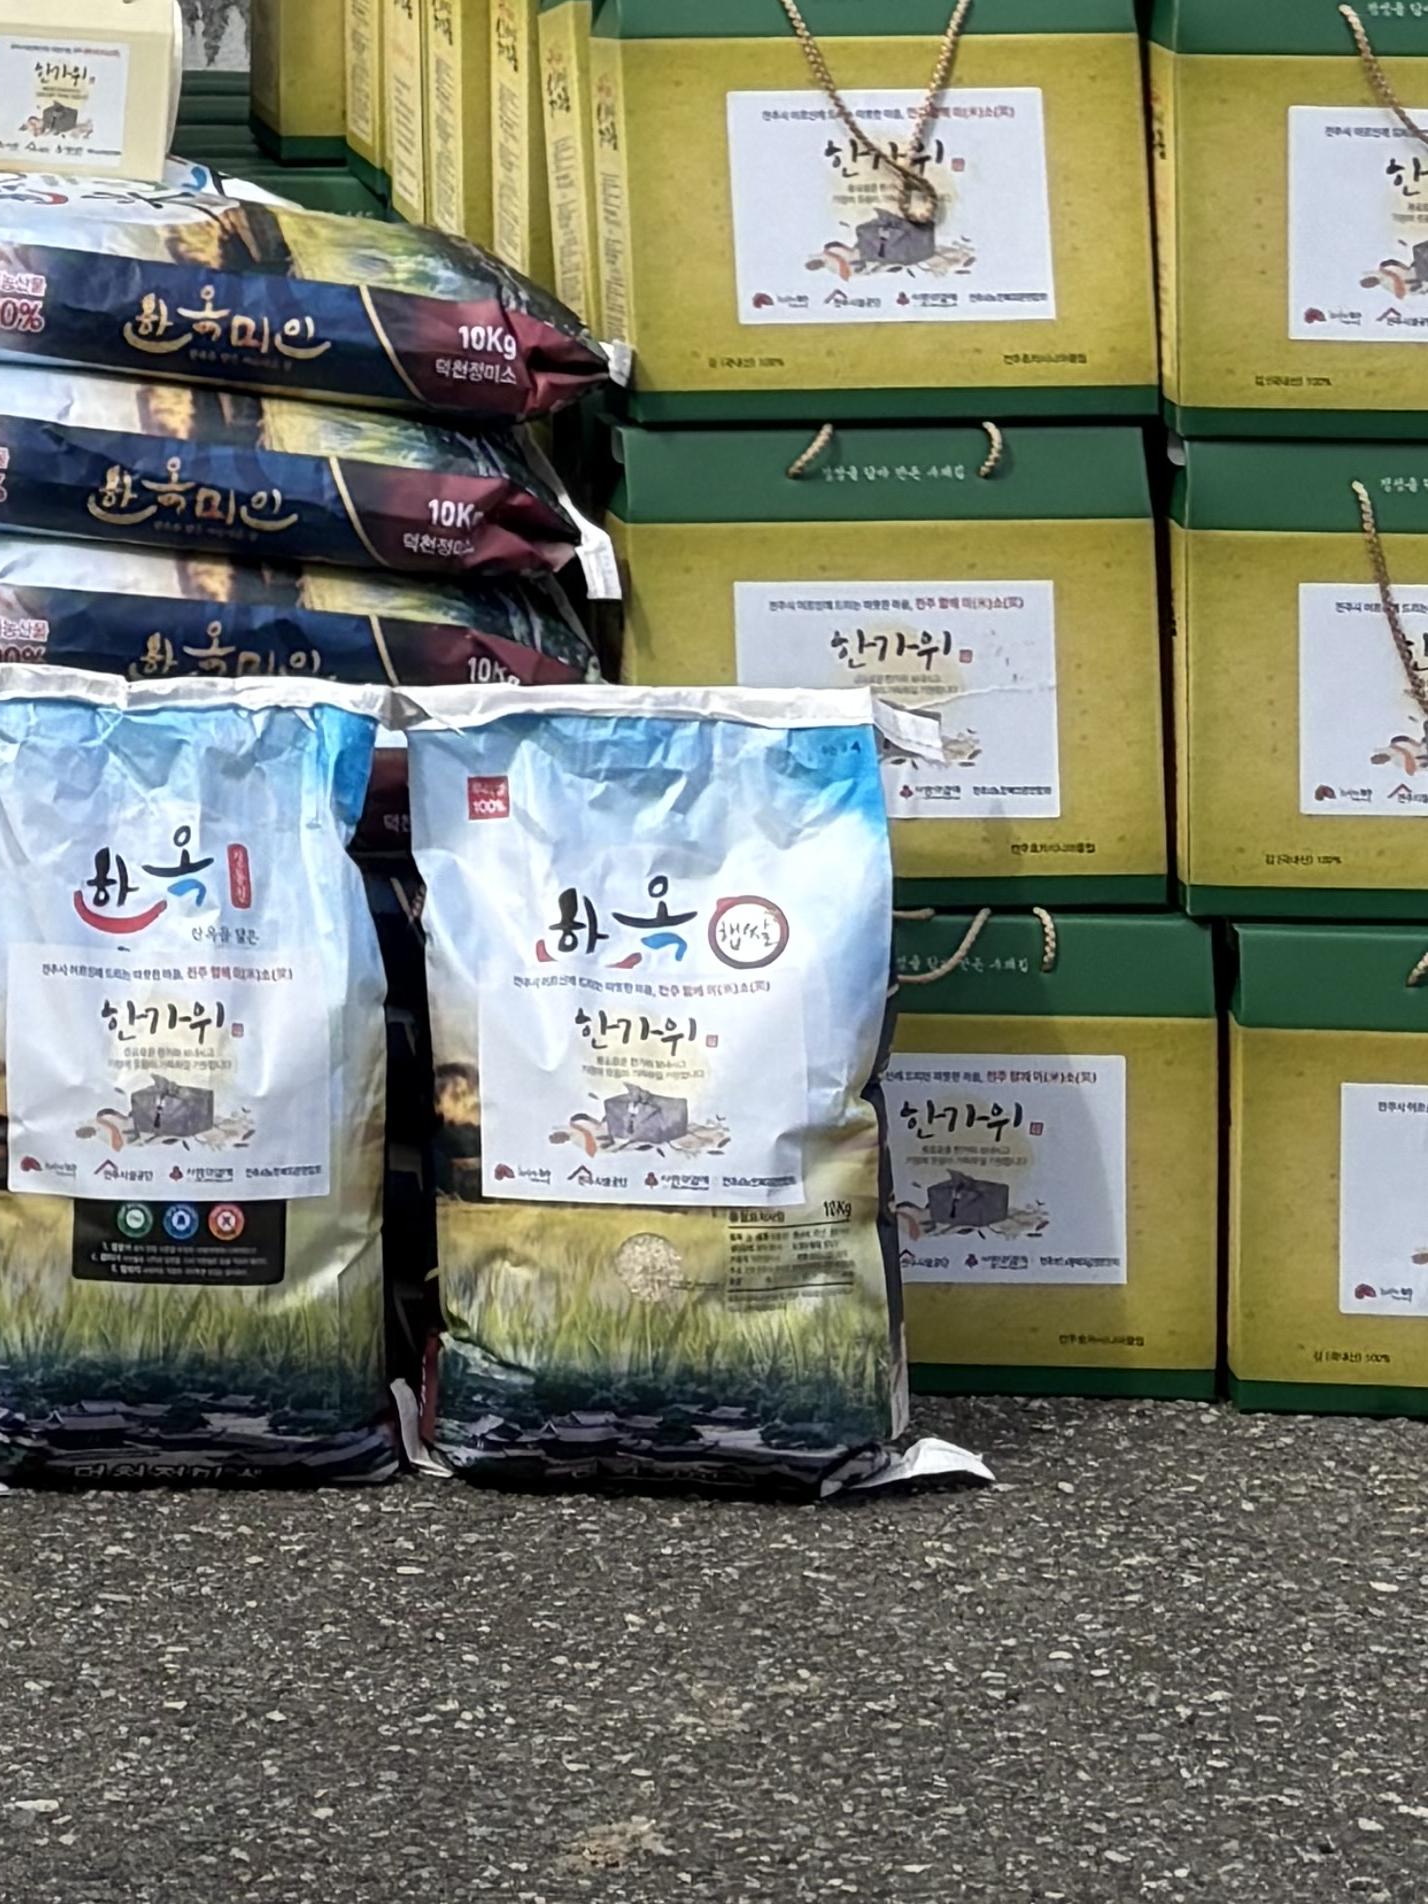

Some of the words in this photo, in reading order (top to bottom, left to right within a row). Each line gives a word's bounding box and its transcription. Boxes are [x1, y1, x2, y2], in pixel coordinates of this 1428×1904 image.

[122, 283, 332, 358] 한옥미인
[458, 322, 518, 359] 10Kg
[434, 356, 518, 387] 덕천정미소
[86, 456, 298, 532] 한옥미인
[830, 630, 952, 670] 한가위
[471, 799, 508, 816] 100%
[101, 999, 225, 1045] 한가위
[574, 1007, 697, 1057] 한가위
[899, 1100, 1024, 1141] 한가위
